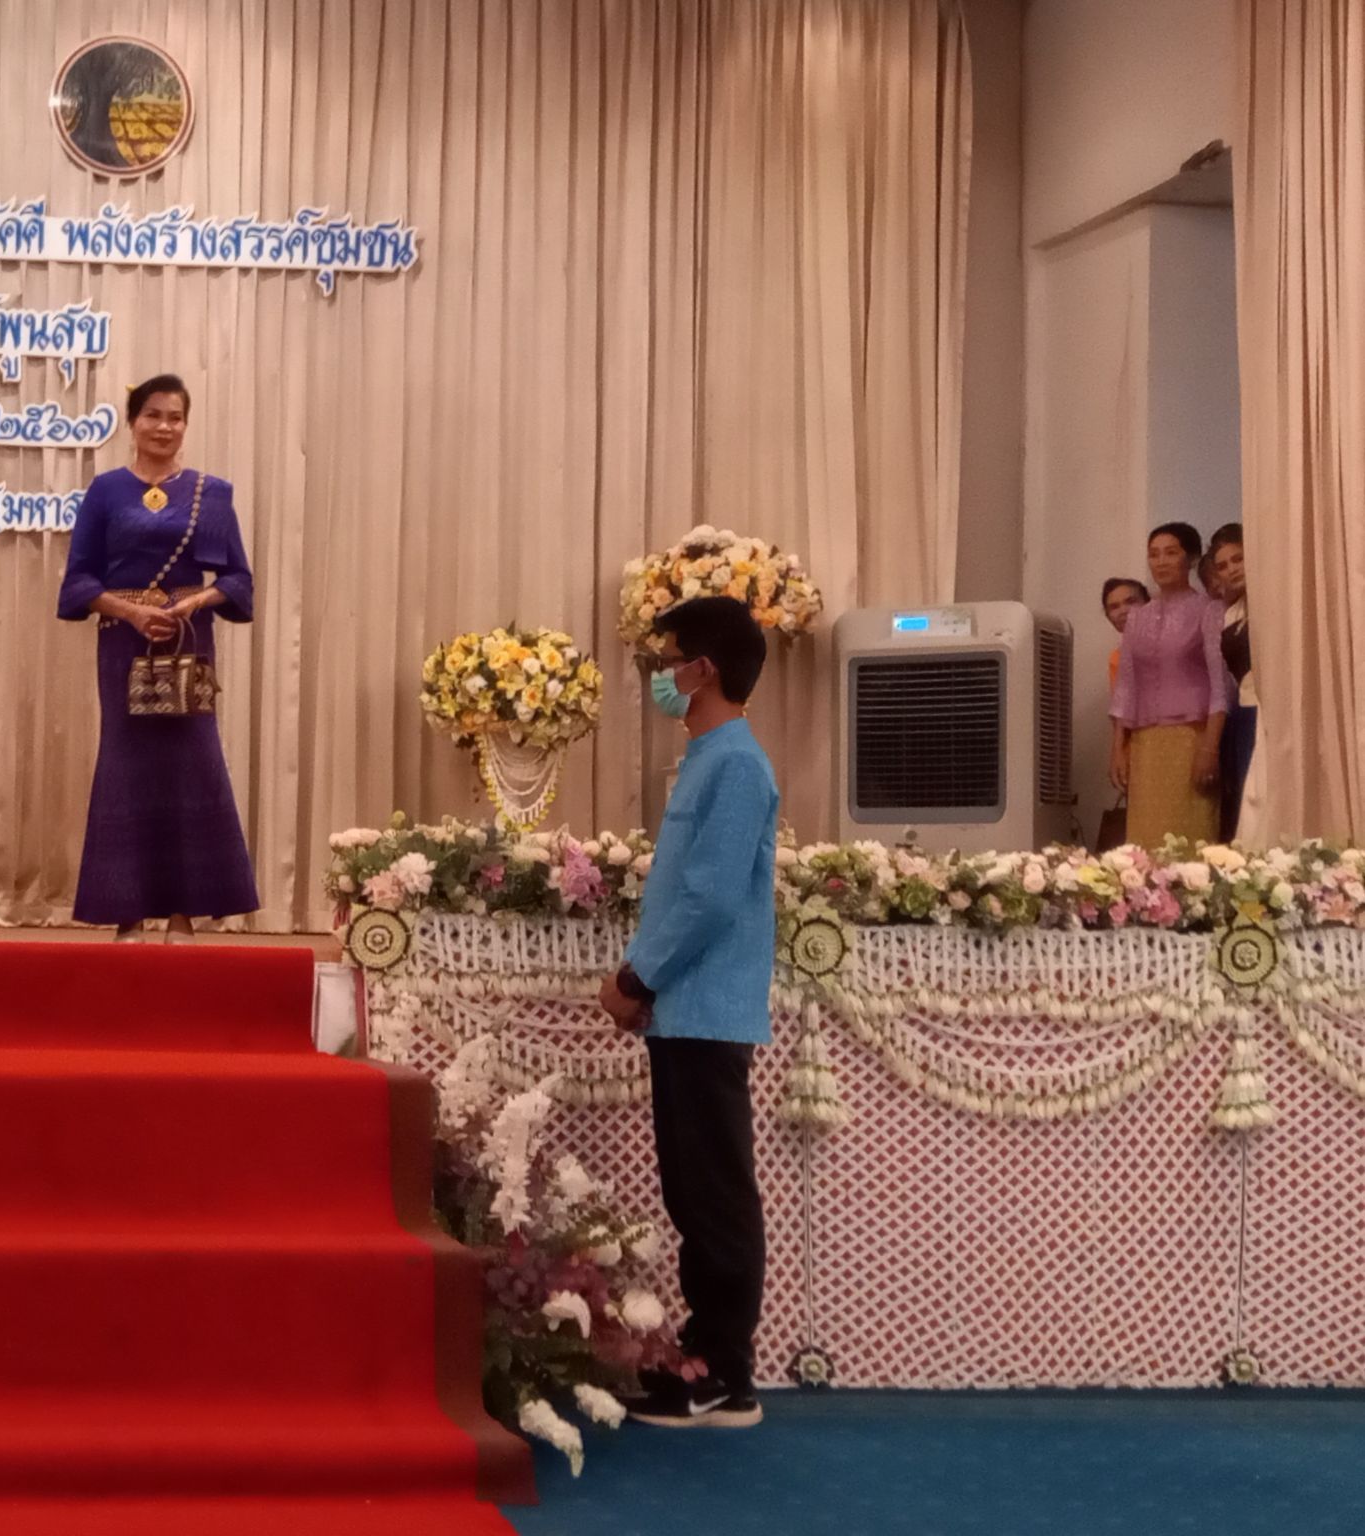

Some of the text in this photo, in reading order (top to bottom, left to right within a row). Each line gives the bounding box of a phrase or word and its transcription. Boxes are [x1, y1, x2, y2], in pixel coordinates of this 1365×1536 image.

[61, 205, 414, 292] พลังสร้างสรรค์ชุมชน
